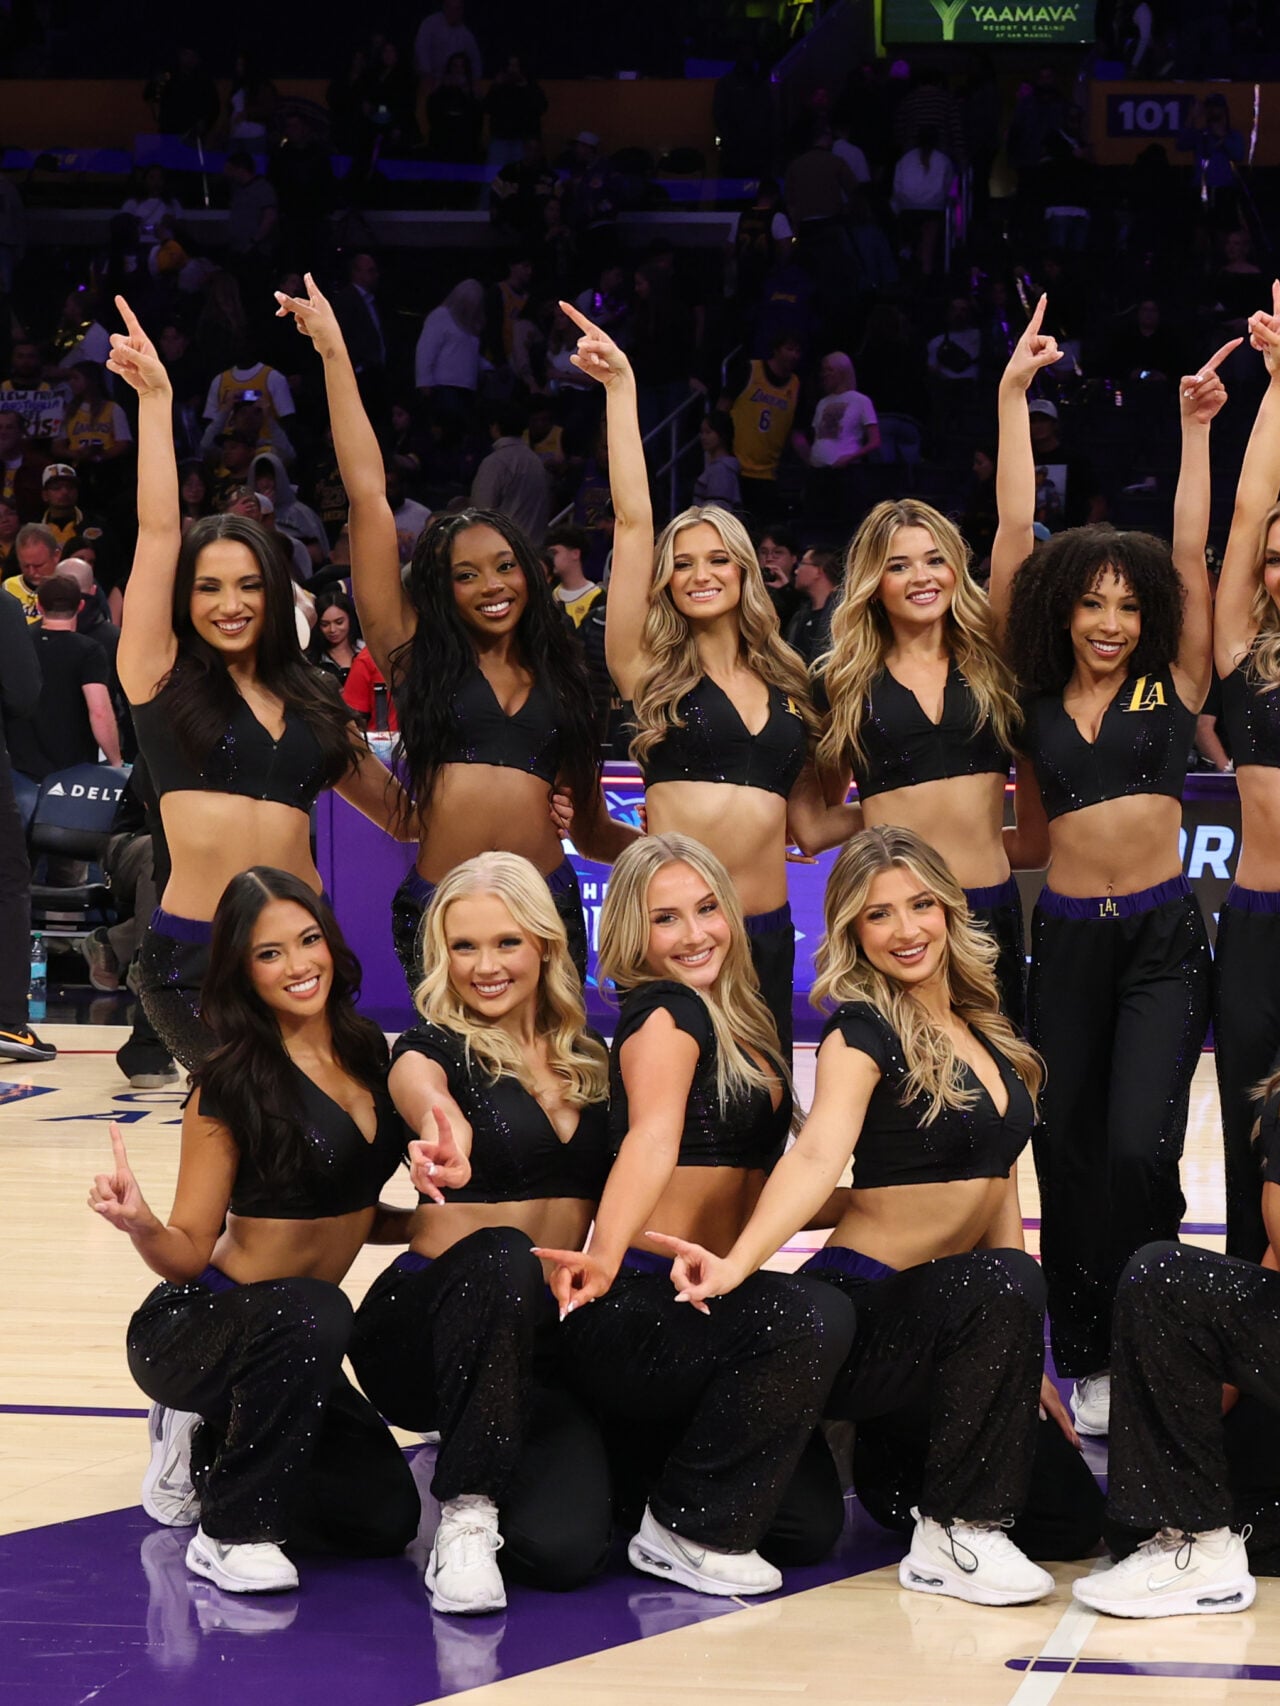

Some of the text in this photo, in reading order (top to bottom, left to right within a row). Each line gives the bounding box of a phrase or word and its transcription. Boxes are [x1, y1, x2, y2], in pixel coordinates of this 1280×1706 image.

[1118, 100, 1180, 131] 101
[758, 410, 771, 433] 6
[1120, 673, 1168, 712] LA
[70, 784, 127, 803] DELT
[1099, 897, 1119, 917] LAL
